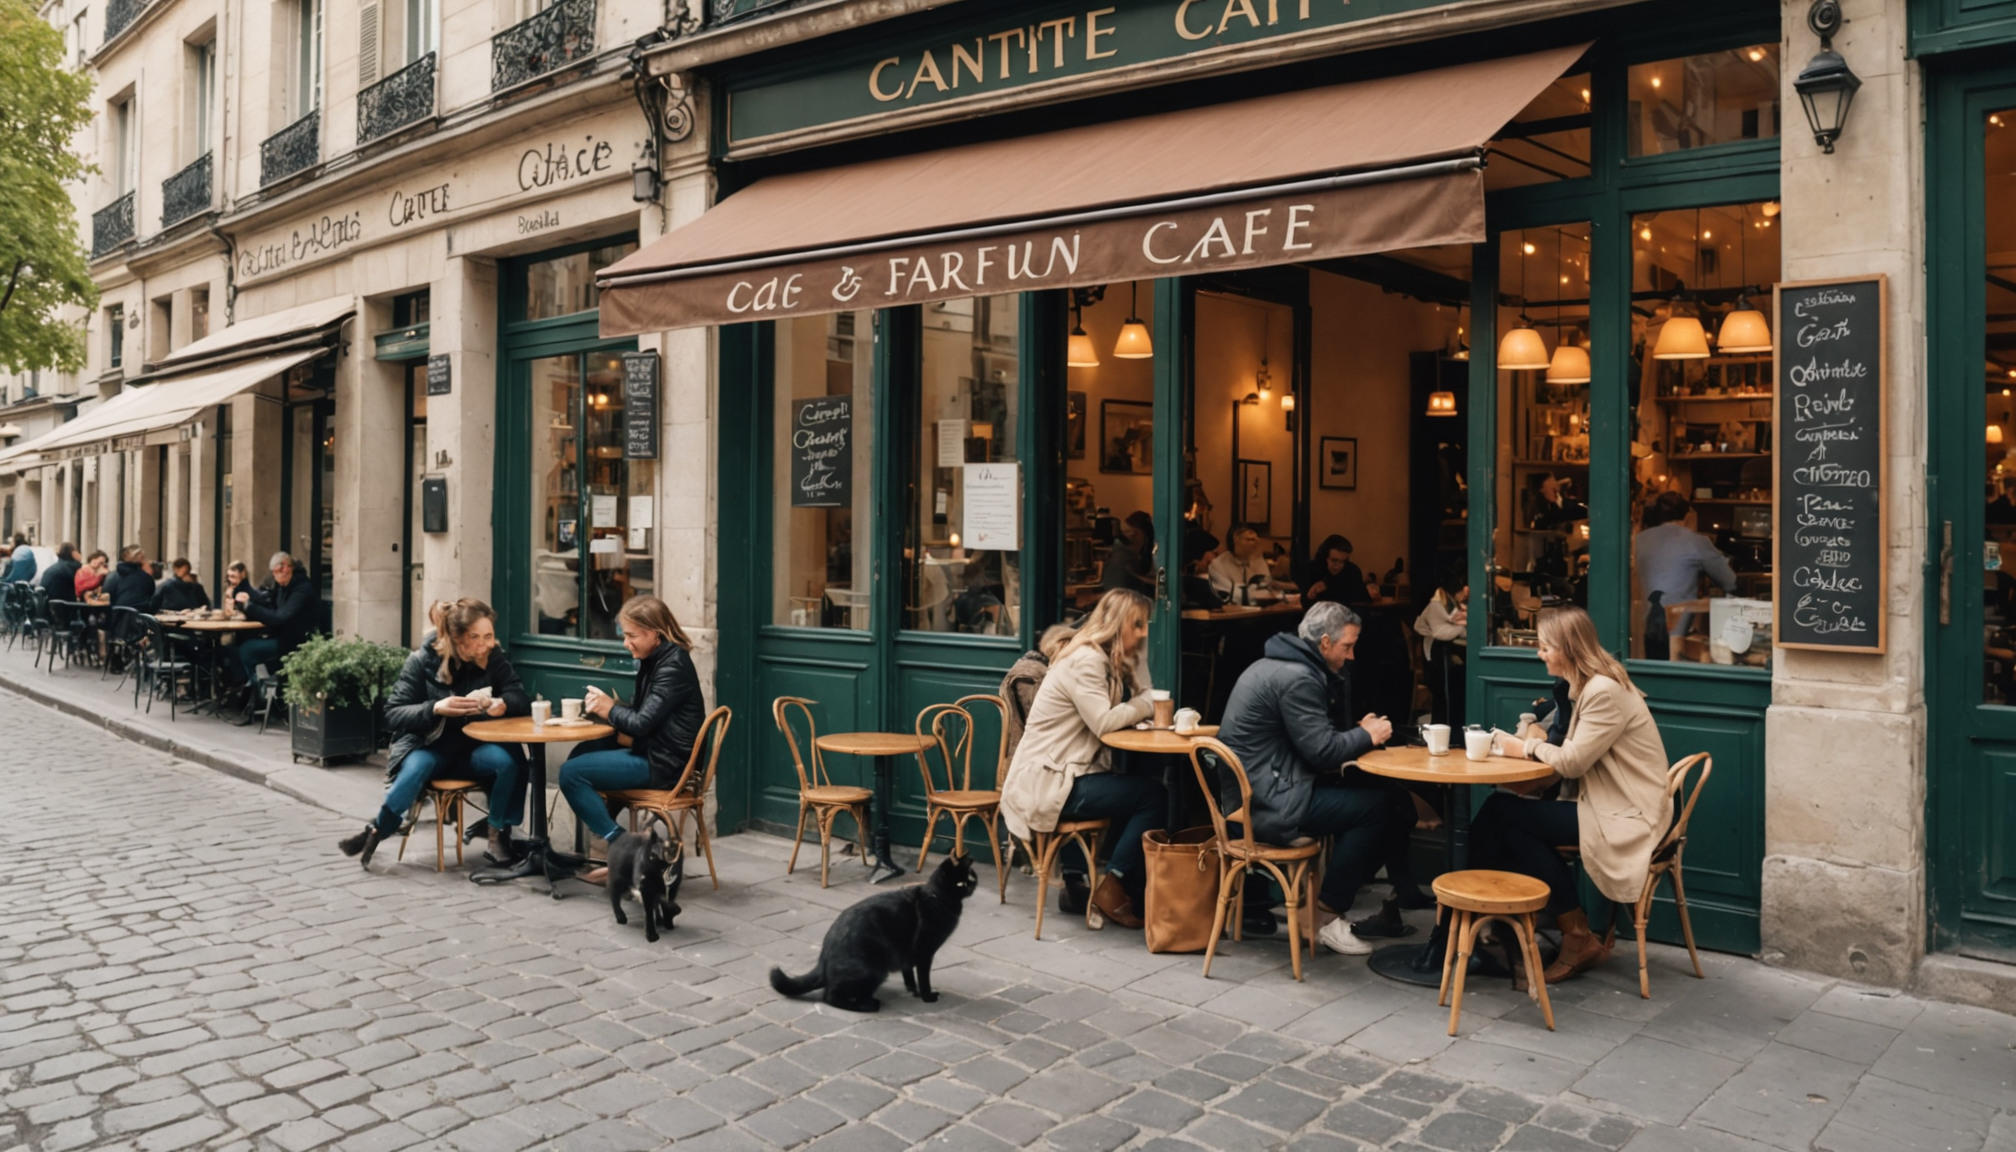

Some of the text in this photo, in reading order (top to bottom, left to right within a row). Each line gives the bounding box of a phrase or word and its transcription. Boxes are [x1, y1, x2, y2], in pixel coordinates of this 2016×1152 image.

[868, 7, 1118, 101] CANTITE
[884, 230, 1081, 297] FARFUN
[1142, 204, 1315, 264] CAFE
